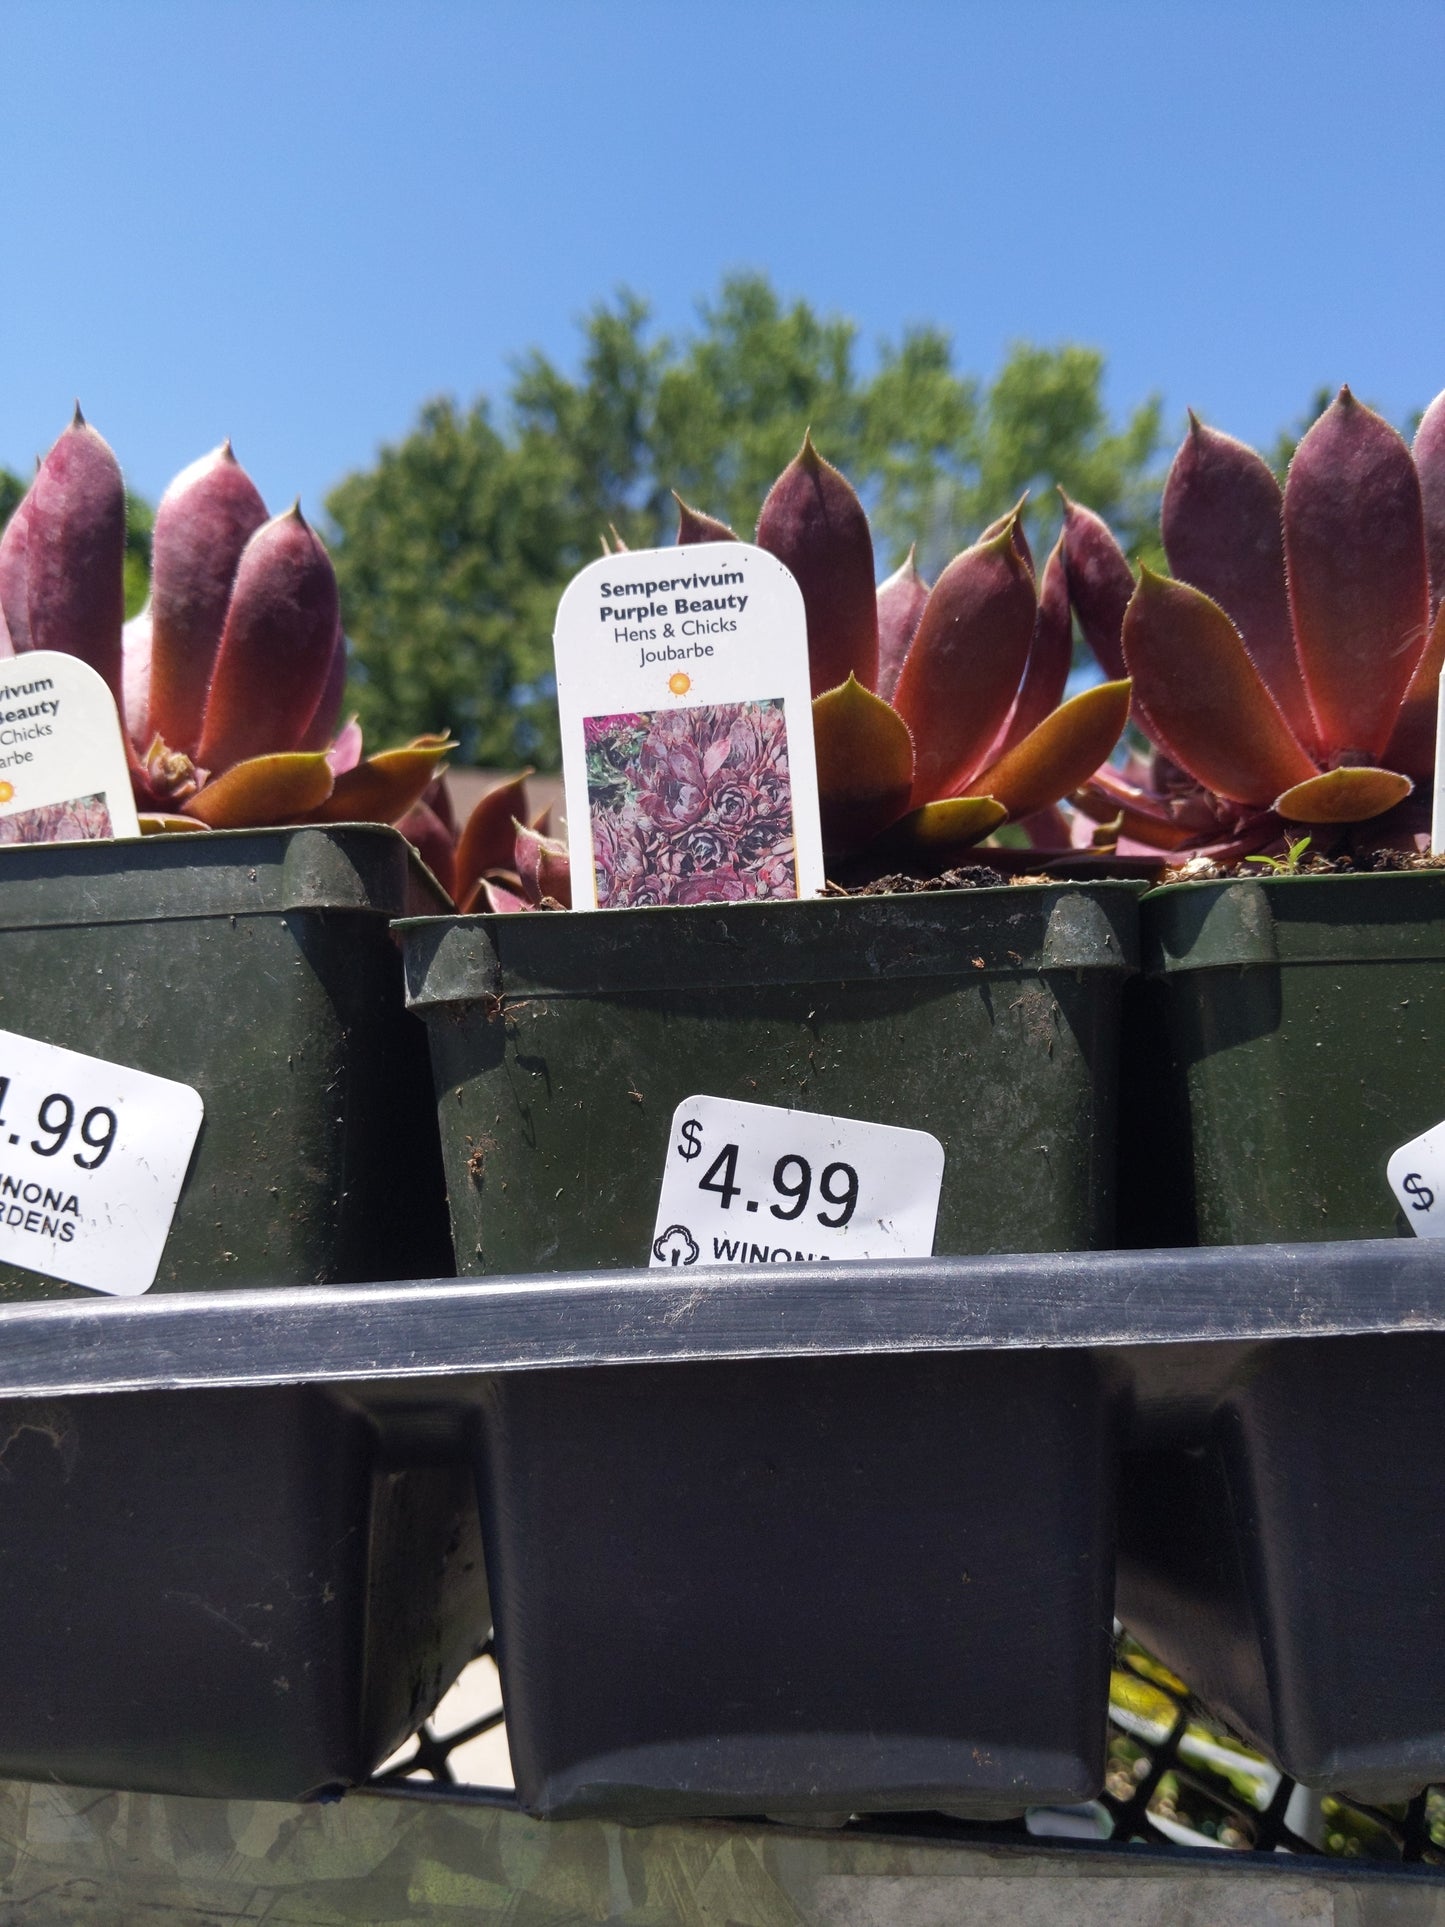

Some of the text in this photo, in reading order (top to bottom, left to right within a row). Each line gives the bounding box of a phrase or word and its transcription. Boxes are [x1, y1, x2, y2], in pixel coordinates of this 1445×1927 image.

[600, 571, 744, 599] Sempervivum
[600, 594, 748, 622] Purple Beauty
[614, 617, 737, 643] Hens & Chicks
[640, 642, 714, 668] Joubarbe
[0, 723, 53, 746] Chicks
[713, 1237, 831, 1263] WINO
